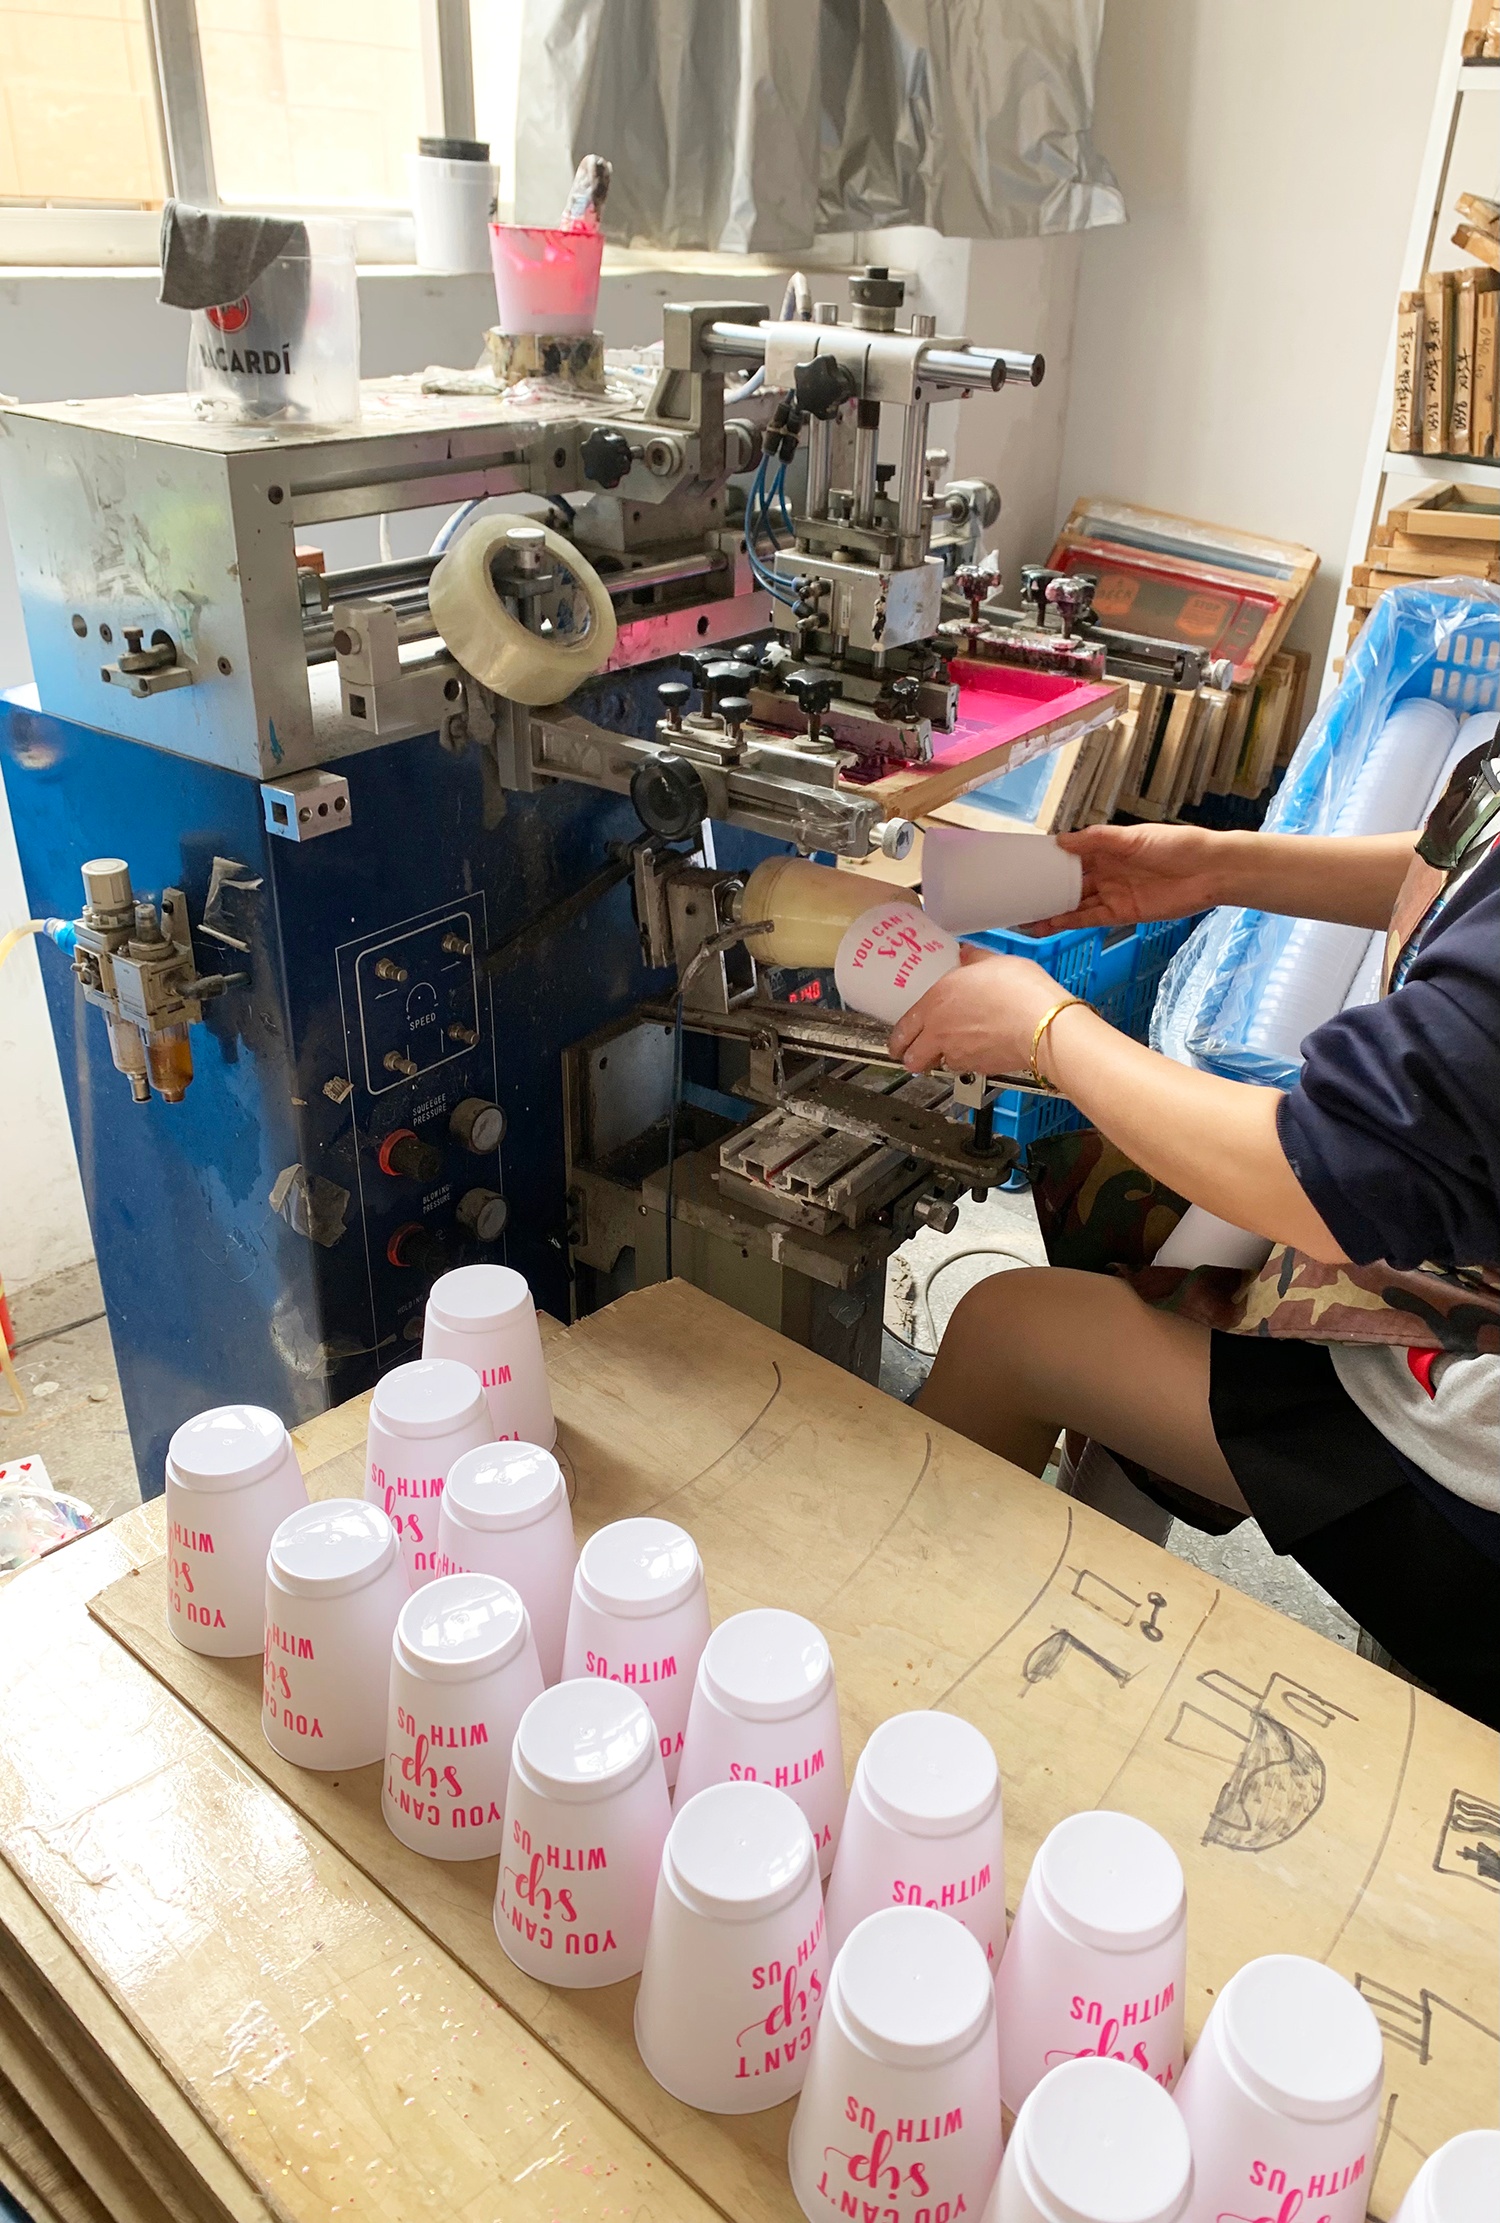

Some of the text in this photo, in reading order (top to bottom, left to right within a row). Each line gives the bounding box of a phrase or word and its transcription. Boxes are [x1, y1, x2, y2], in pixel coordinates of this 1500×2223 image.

[852, 938, 874, 970] YOU
[878, 926, 923, 959] sip
[893, 938, 945, 990] WITH US
[409, 1011, 437, 1032] SPEED
[411, 1092, 447, 1117] SQUEEGEE
[412, 1103, 448, 1128] PRESSURE
[422, 1184, 451, 1206] BLOWING
[422, 1195, 451, 1216] PRESSURE
[482, 1365, 512, 1388] WIT
[371, 1463, 446, 1499] WITH US
[174, 1520, 215, 1554] WITH
[187, 1603, 227, 1629] YOU
[272, 1622, 315, 1661] WITH
[586, 1650, 678, 1685] WITH US
[283, 1709, 324, 1739] YOU
[397, 1706, 489, 1748] WITH US
[660, 1731, 685, 1759] YO
[389, 1733, 464, 1799] sip
[729, 1749, 825, 1789] WITH US
[388, 1776, 501, 1829] YOU CAN'T
[513, 1820, 608, 1872] WITH US
[503, 1853, 578, 1923] sip
[892, 1864, 992, 1908] WITH US
[500, 1888, 618, 1956] YOU CAN'T
[752, 1961, 783, 1990] US
[736, 1965, 823, 2049] sip
[1069, 1982, 1174, 2028] WITH US
[735, 2025, 812, 2079] CAN'T
[845, 2095, 963, 2143] WITH US
[824, 2128, 930, 2201] sip
[1249, 2153, 1366, 2199] WITH US
[914, 2193, 967, 2223] YOU
